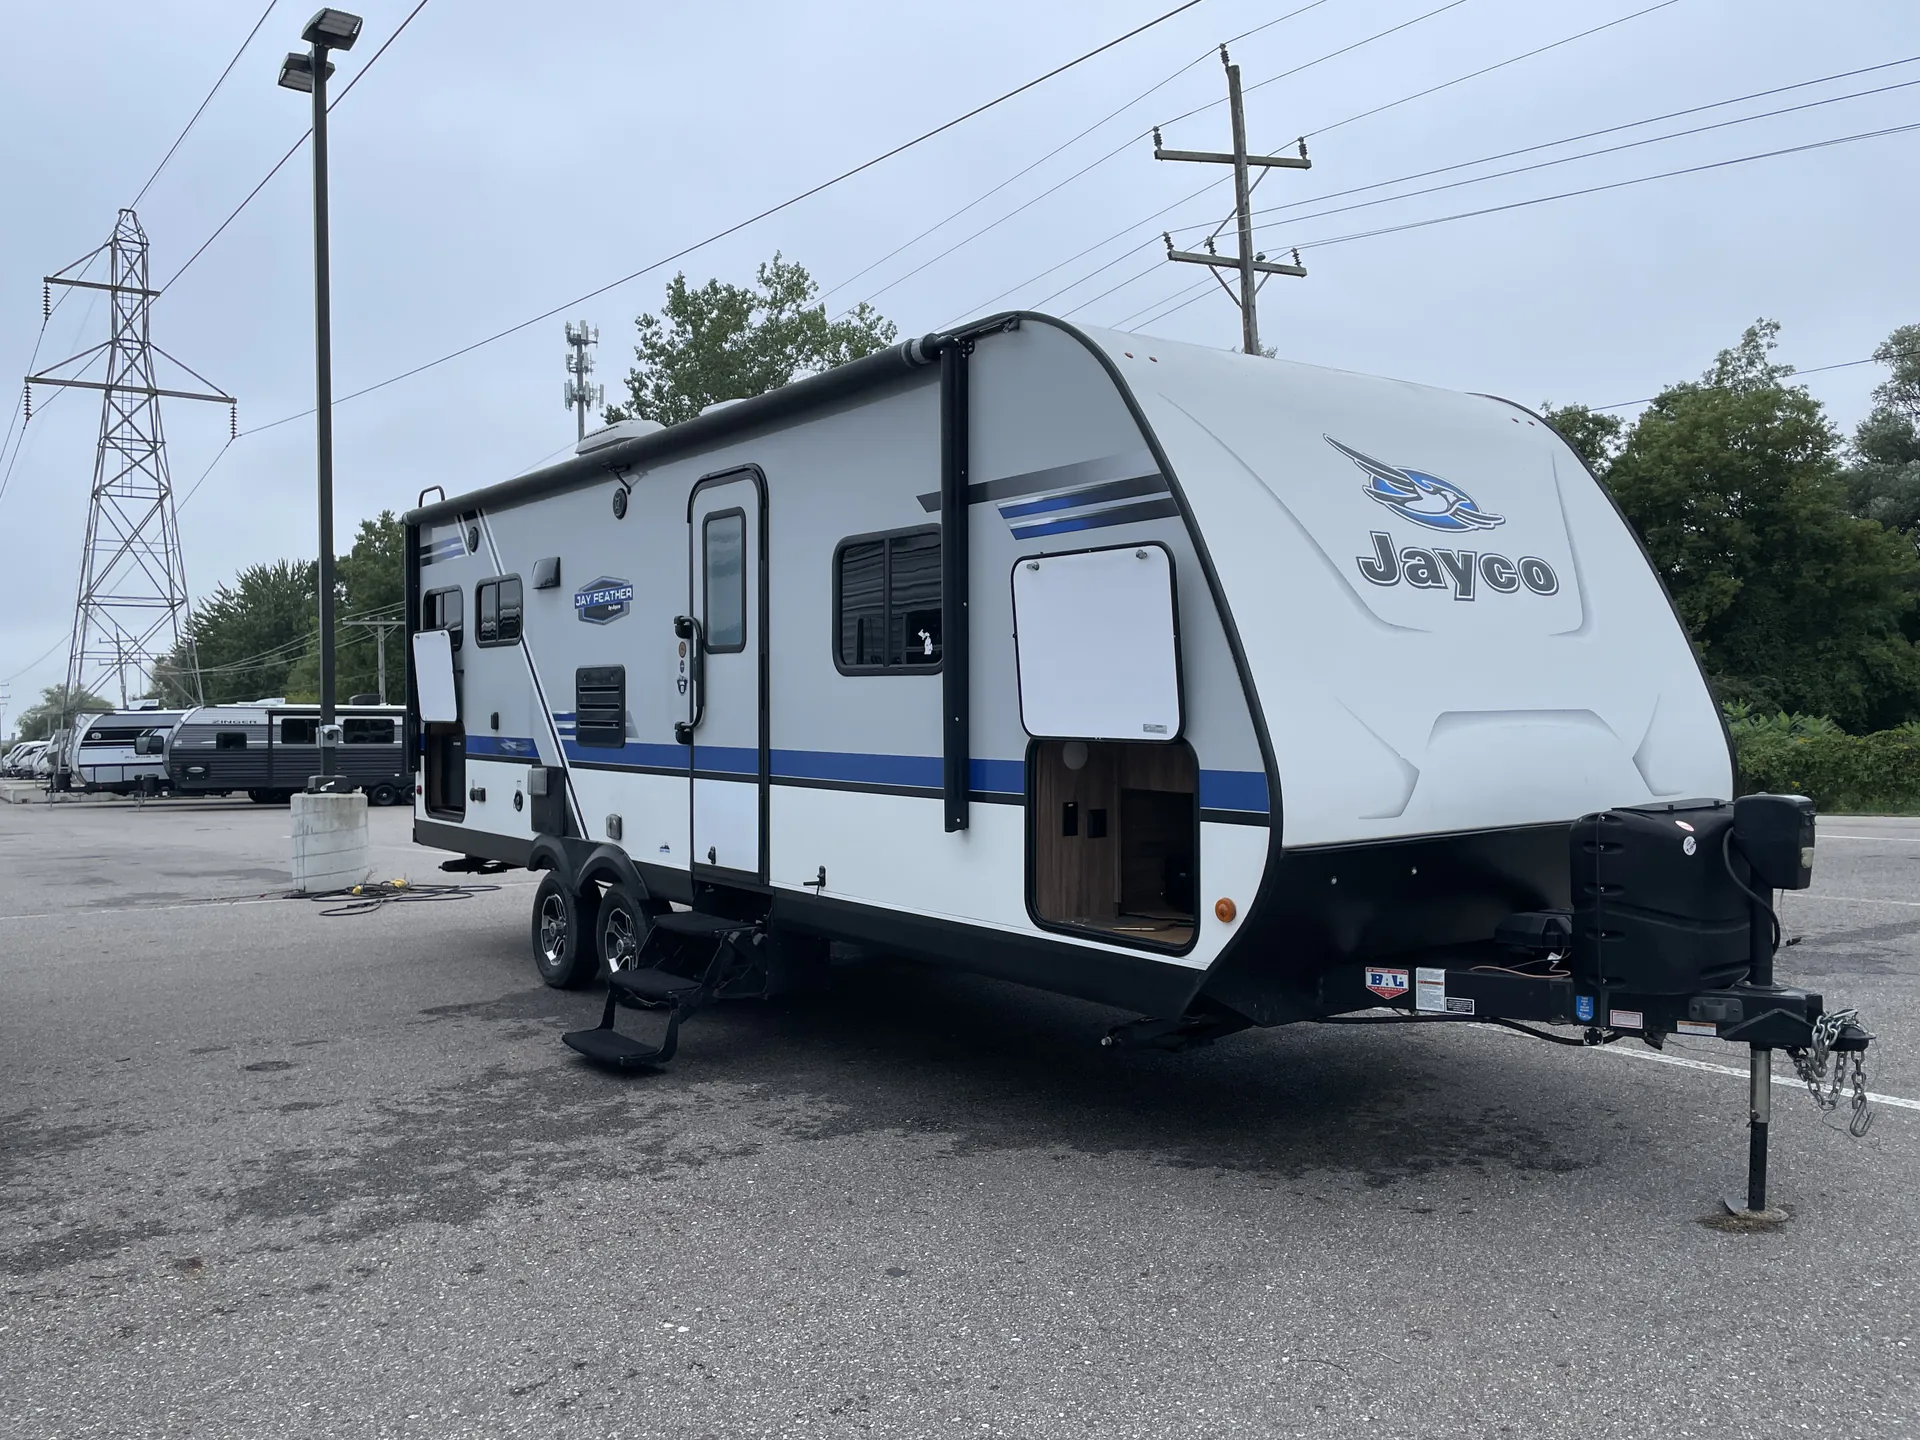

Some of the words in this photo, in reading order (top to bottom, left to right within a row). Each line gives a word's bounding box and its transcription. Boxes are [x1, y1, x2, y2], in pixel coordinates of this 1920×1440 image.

[1356, 531, 1559, 601] Jayco
[575, 594, 592, 607] JAY
[593, 588, 632, 603] FEATHER
